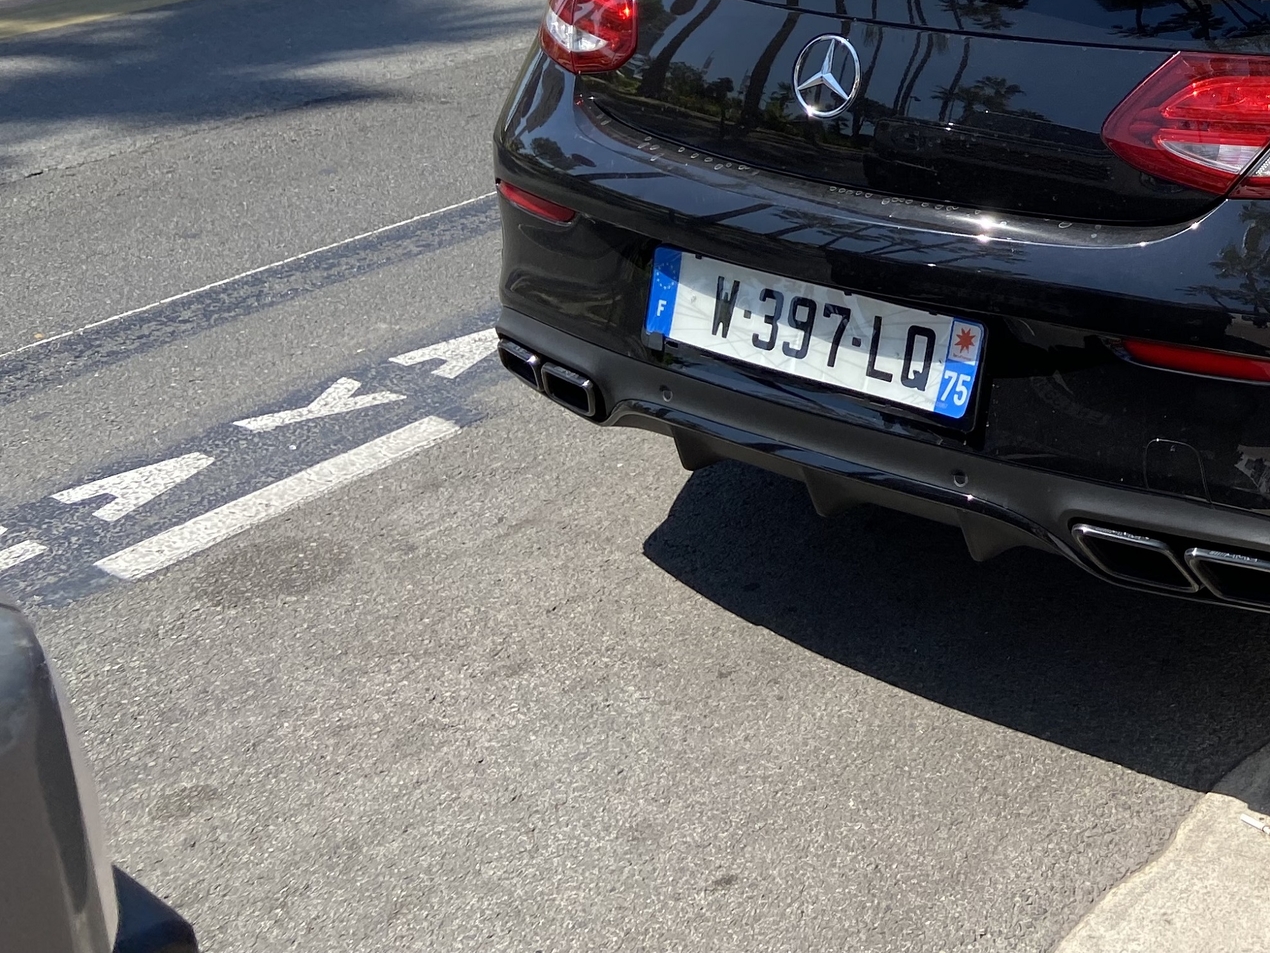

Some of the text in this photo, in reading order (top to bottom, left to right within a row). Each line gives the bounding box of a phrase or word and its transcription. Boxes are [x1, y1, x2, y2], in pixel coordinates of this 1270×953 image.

[656, 300, 667, 317] F
[711, 275, 936, 391] W-397-LQ
[940, 370, 971, 406] 75
